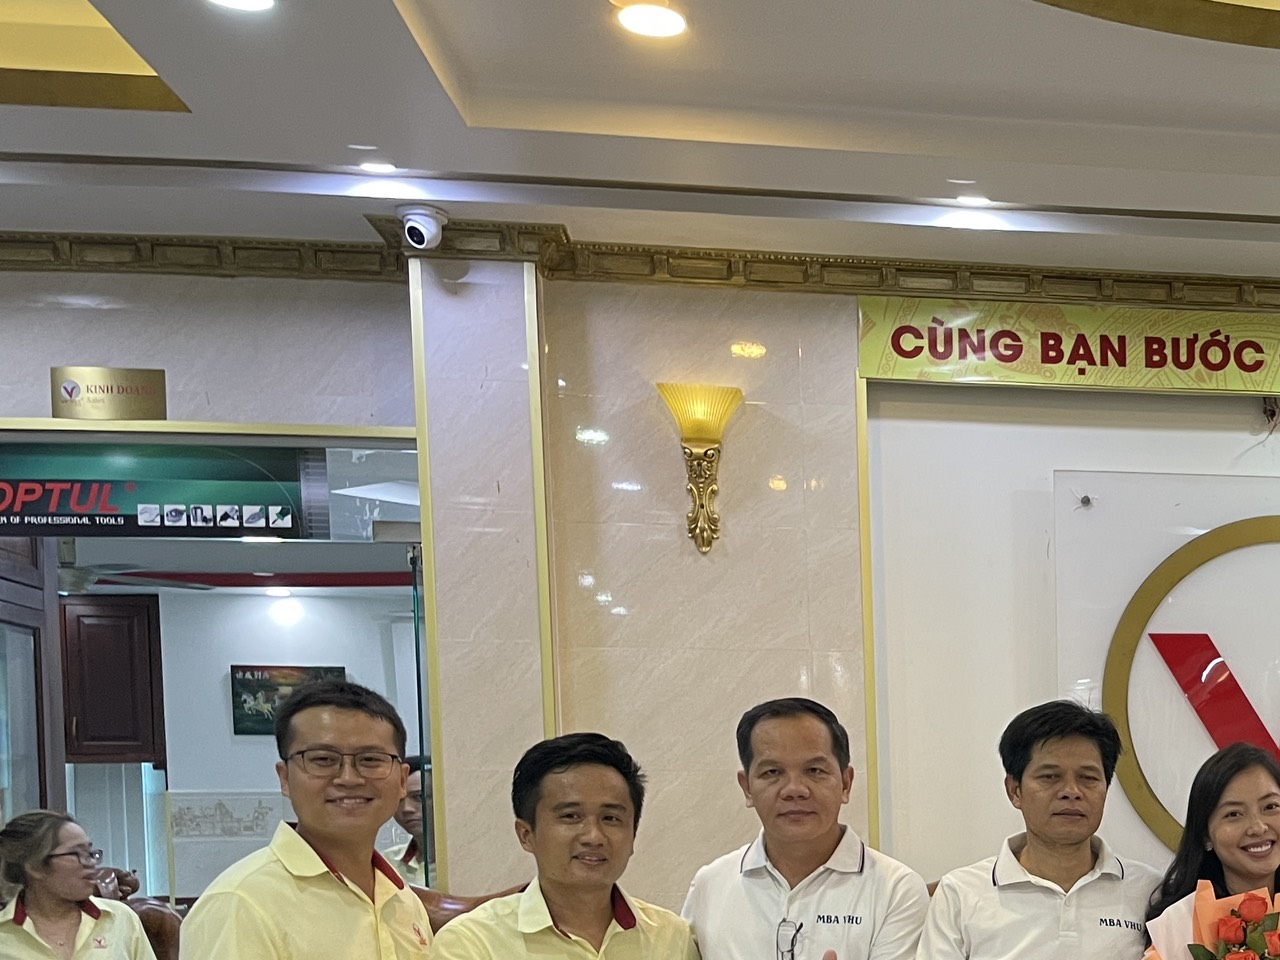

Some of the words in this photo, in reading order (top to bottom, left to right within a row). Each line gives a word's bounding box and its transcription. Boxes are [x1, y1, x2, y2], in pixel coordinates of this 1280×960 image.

[891, 316, 1024, 362] CÙNG
[1040, 331, 1127, 376] BẠN
[1144, 328, 1265, 373] BƯỚC
[86, 384, 113, 395] KINH
[95, 516, 124, 525] TOOLS
[816, 914, 839, 924] MBA
[1099, 918, 1122, 928] MBA
[1124, 920, 1142, 931] VHU
